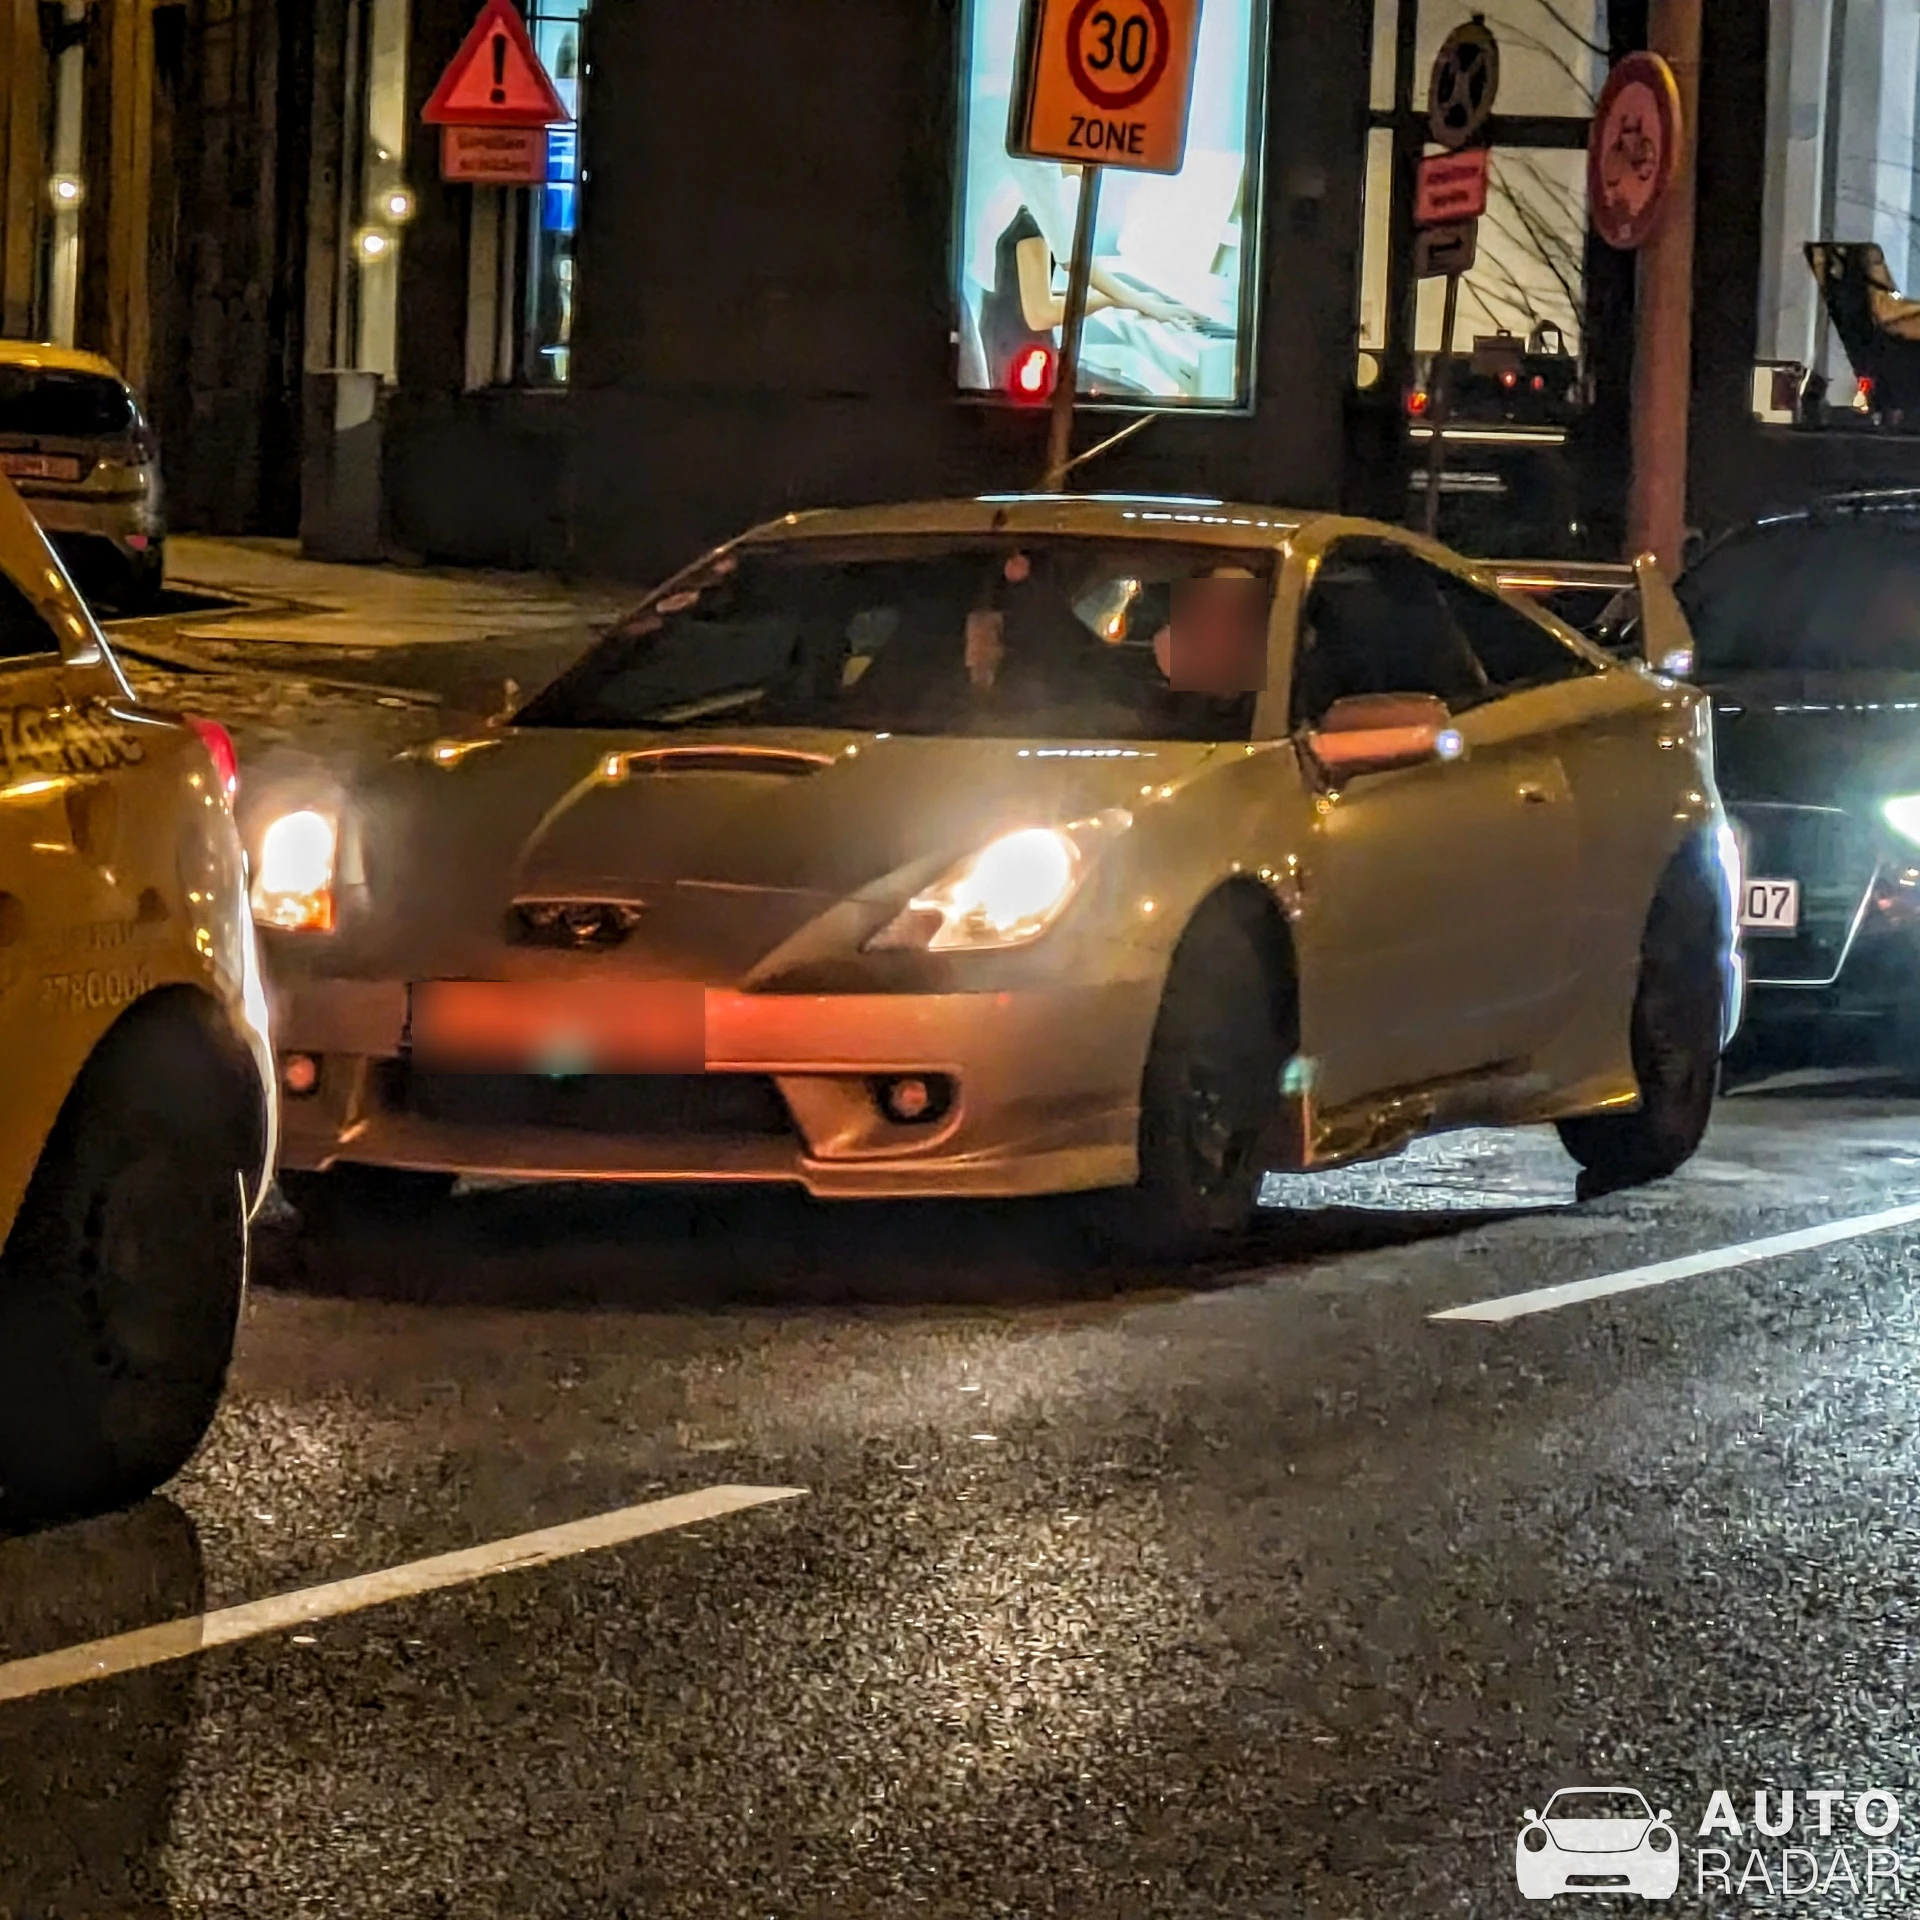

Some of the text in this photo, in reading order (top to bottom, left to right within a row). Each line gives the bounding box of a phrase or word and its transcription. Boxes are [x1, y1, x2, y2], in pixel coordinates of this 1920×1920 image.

[1087, 11, 1148, 74] 30
[1067, 116, 1146, 154] ZONE
[1741, 885, 1790, 919] 07
